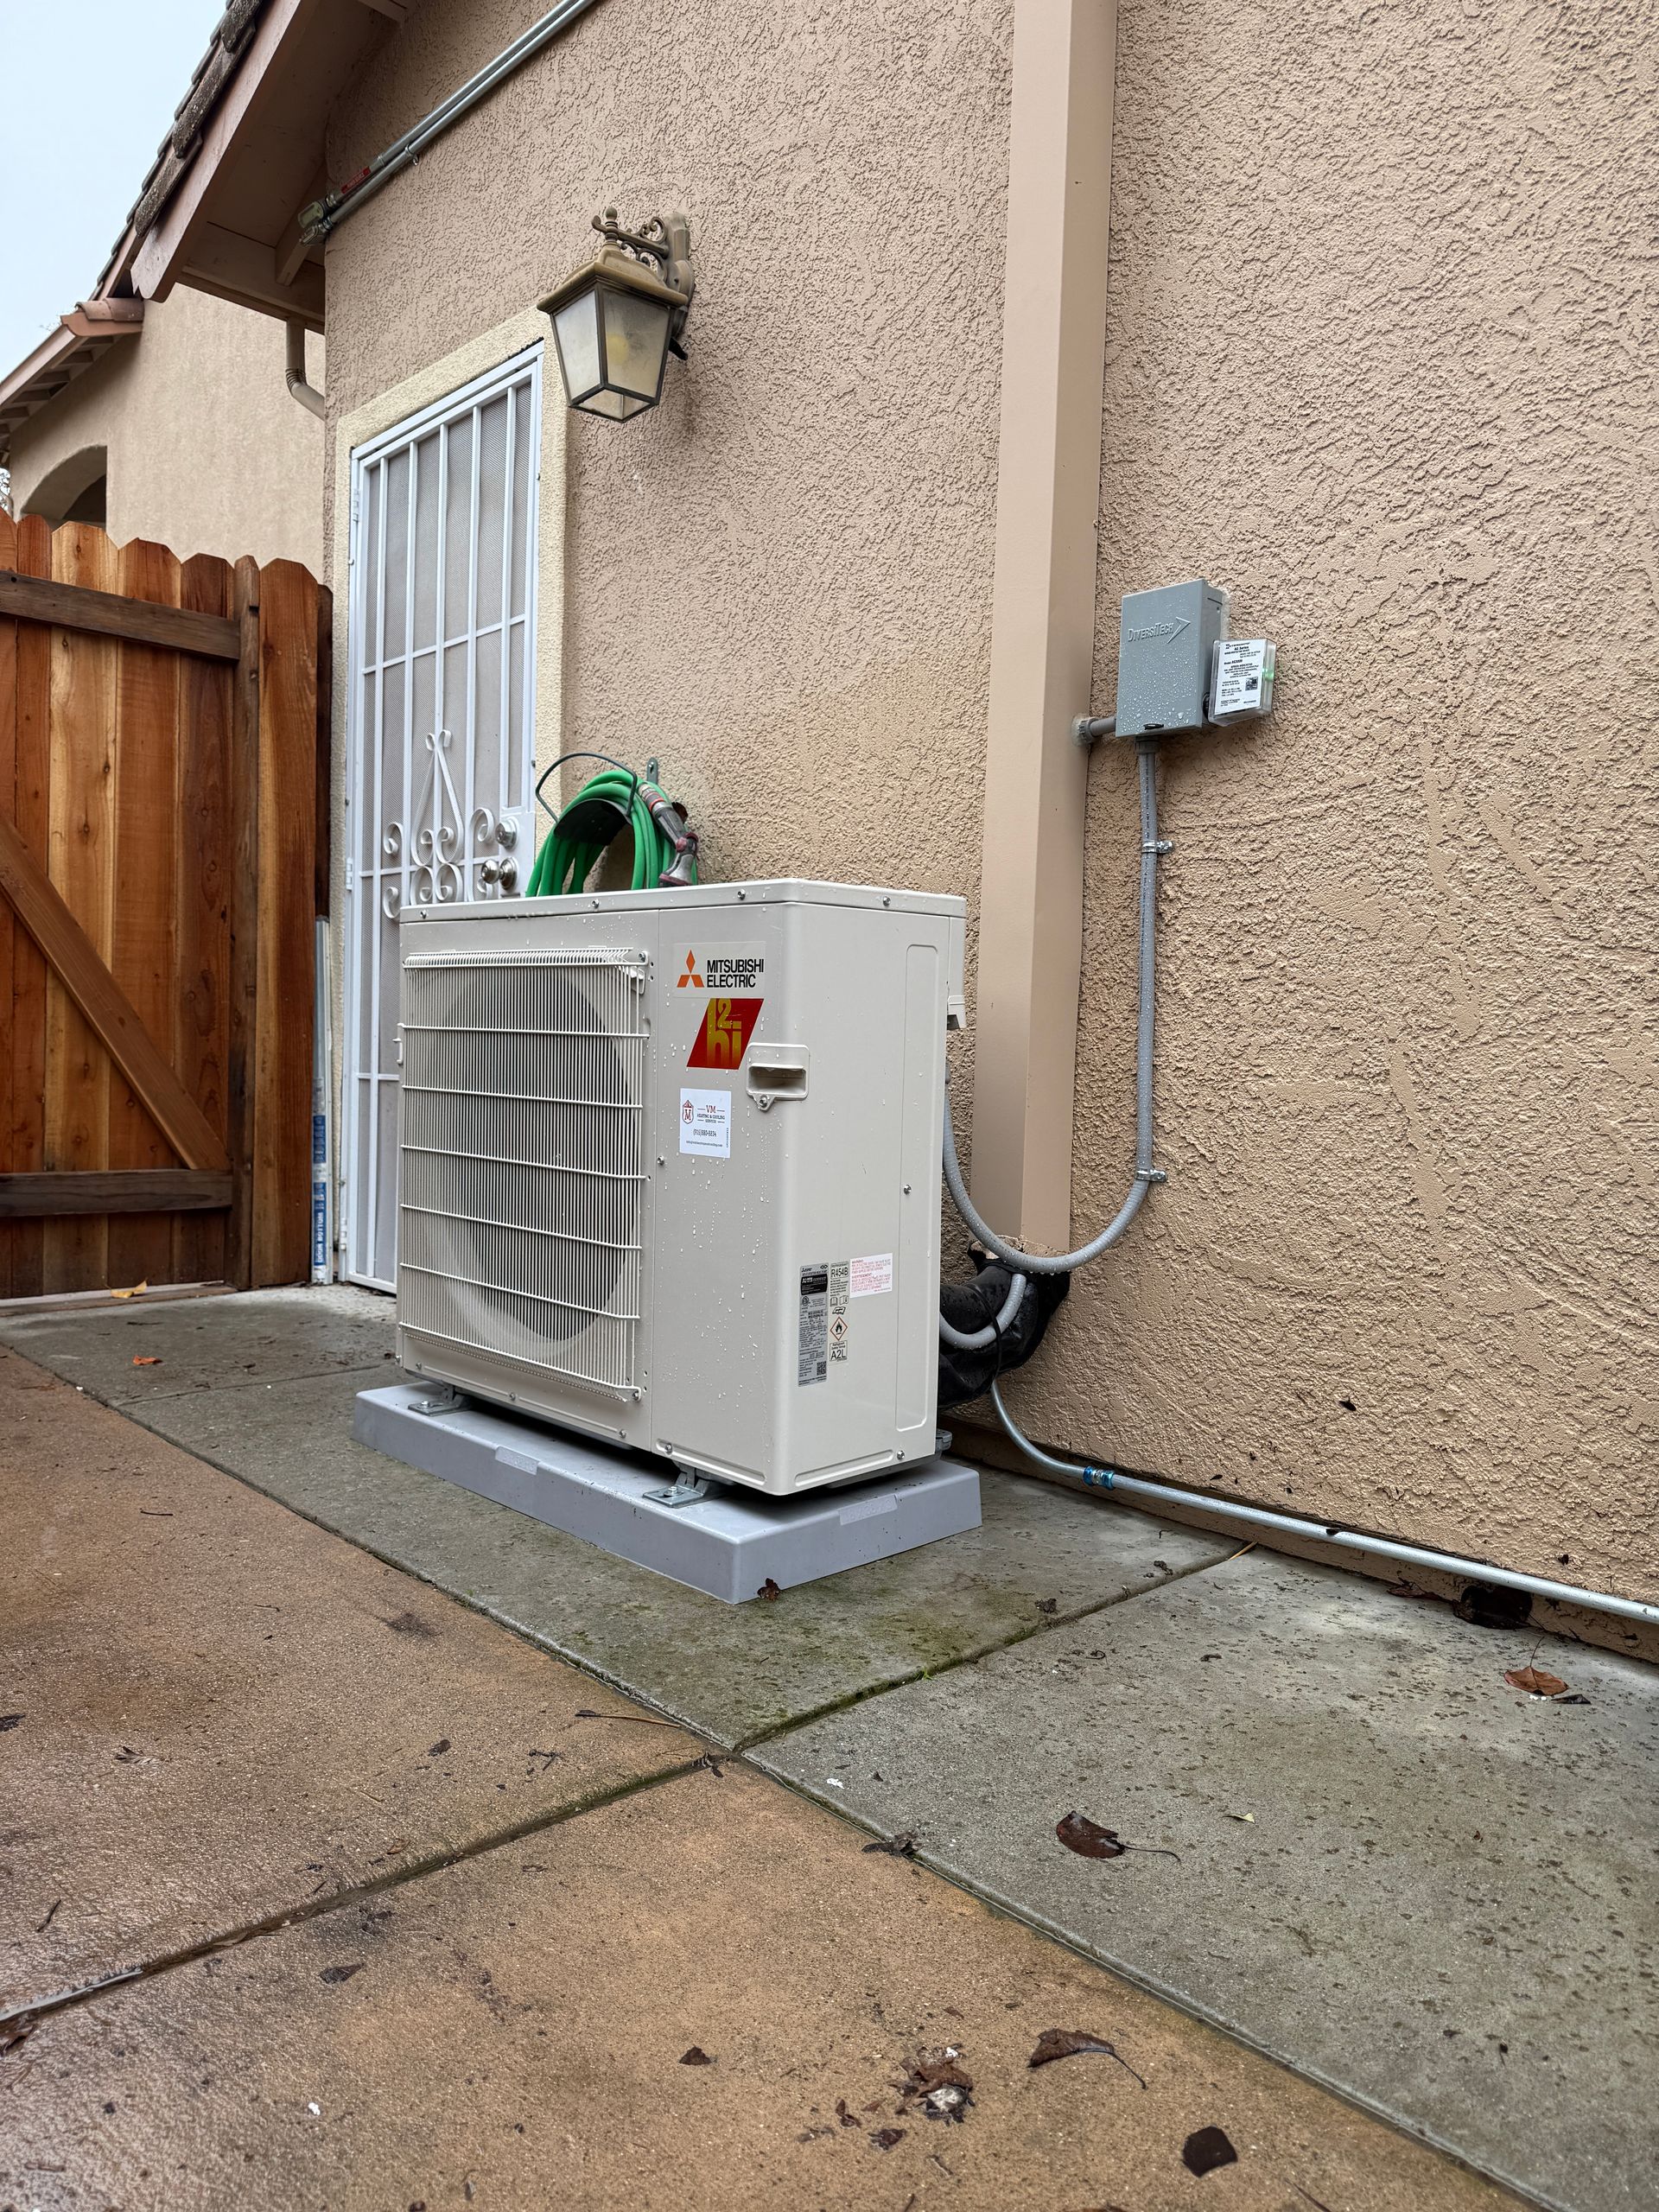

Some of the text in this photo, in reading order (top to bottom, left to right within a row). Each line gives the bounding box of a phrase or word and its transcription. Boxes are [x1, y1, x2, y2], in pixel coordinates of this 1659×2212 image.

[707, 958, 765, 974] MITSUBISHI
[707, 975, 756, 988] ELECTRIC
[831, 1267, 849, 1279] R454B
[830, 1349, 846, 1360] A2L
